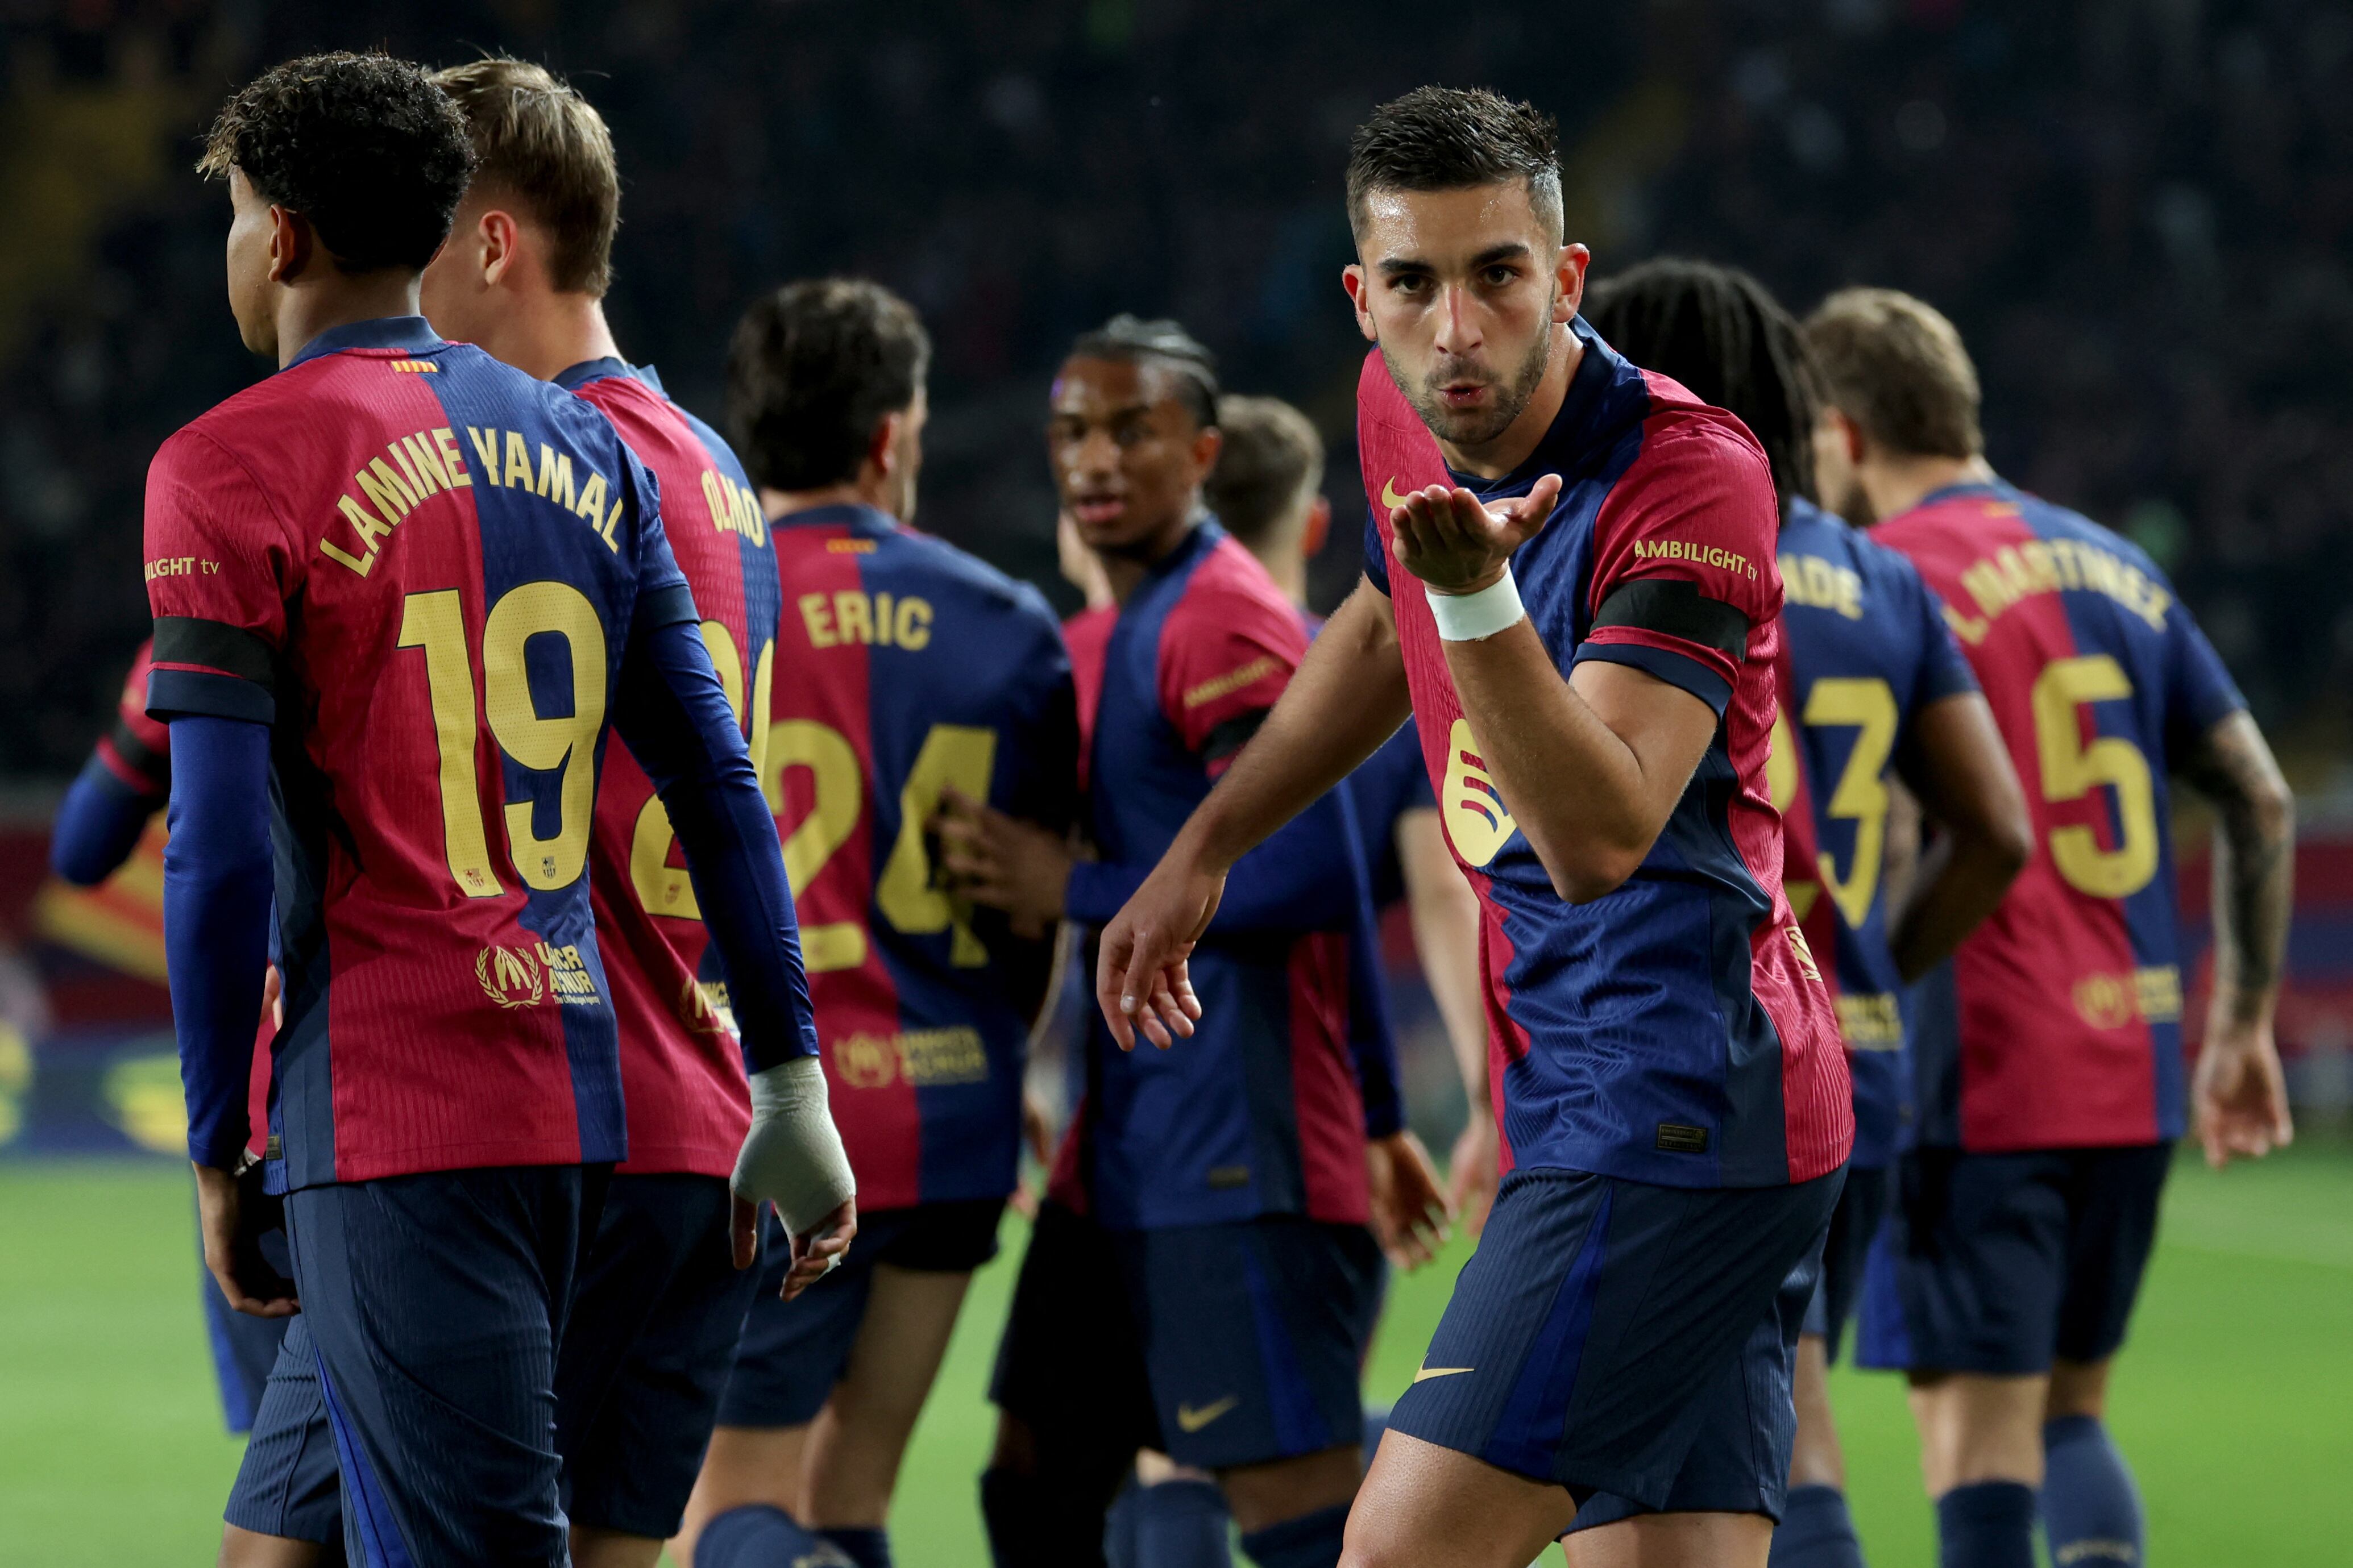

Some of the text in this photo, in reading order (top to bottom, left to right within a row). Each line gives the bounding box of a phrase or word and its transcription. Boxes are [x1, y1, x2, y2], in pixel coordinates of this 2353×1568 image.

[200, 559, 220, 575] tv
[320, 426, 623, 578] LAMINE YAMAL
[1634, 539, 1758, 581] AMBILIGHT tv
[798, 590, 935, 651] ERIC
[396, 581, 607, 899] 19
[2031, 654, 2159, 899] 5
[761, 718, 999, 973] 24
